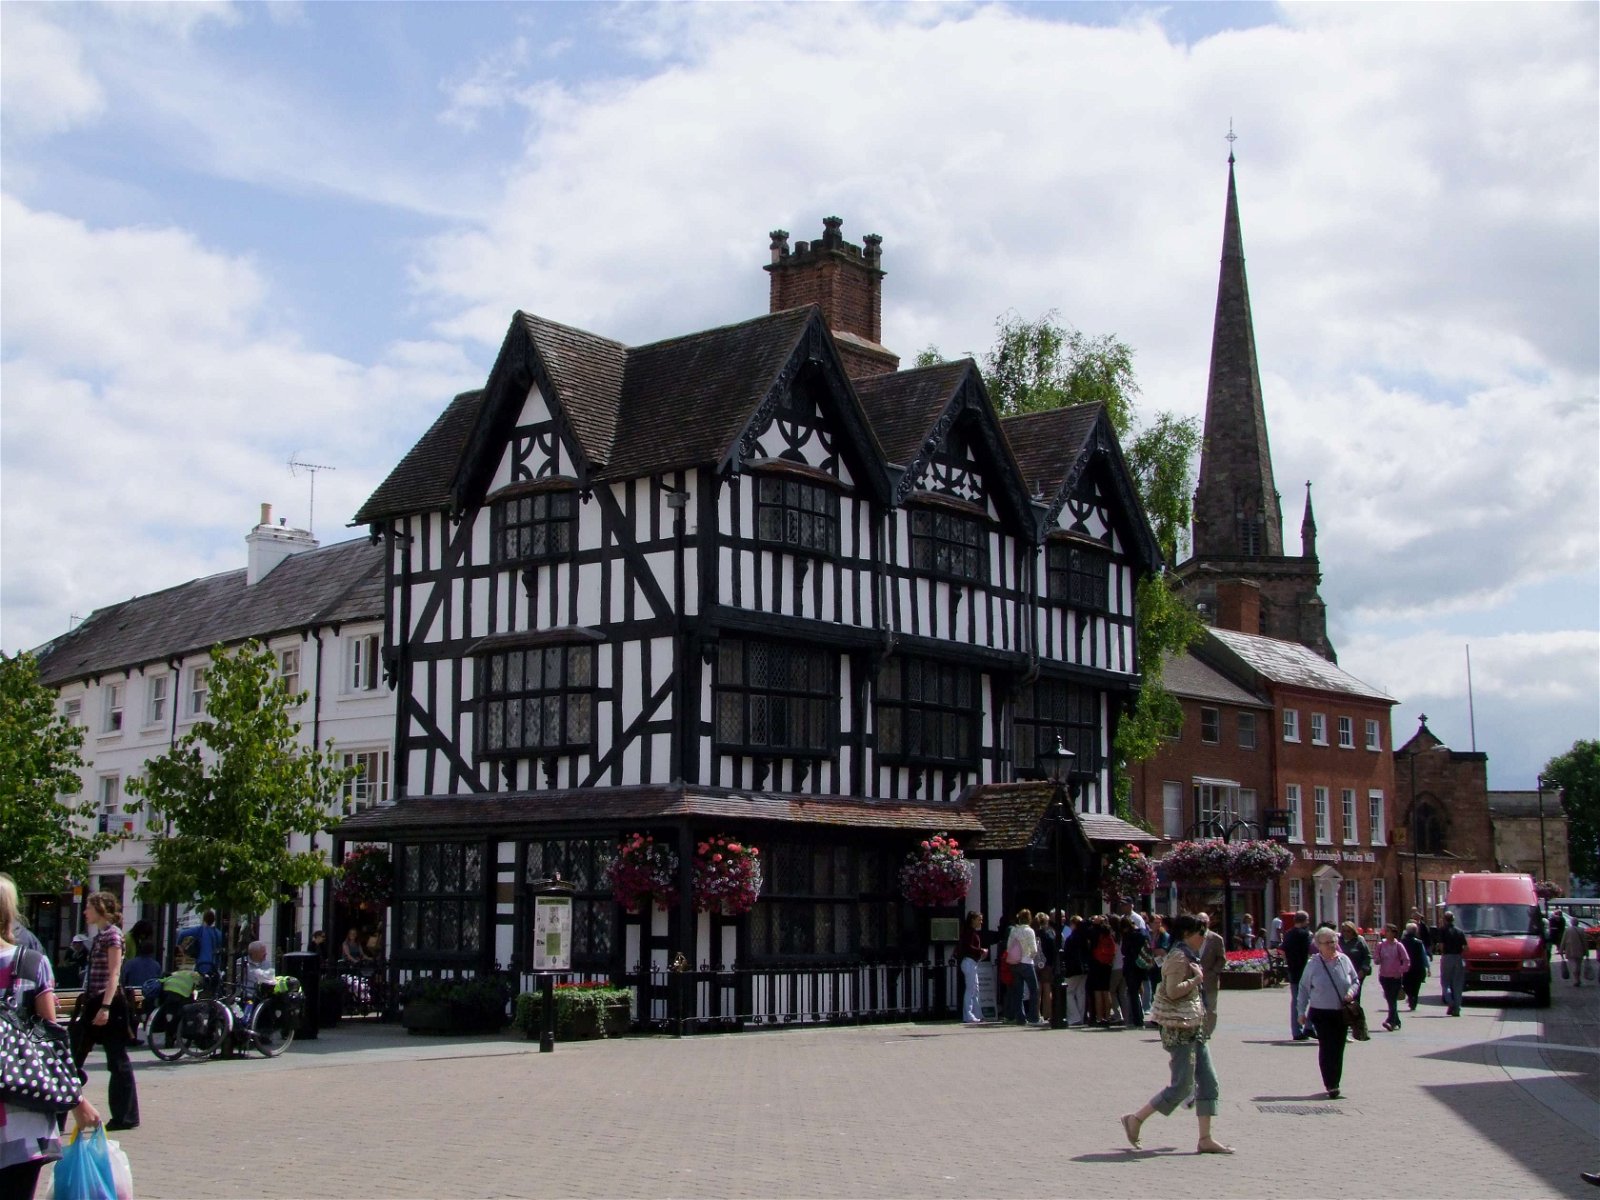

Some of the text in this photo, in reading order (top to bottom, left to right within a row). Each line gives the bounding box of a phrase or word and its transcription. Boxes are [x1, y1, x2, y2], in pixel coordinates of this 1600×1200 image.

[1302, 849, 1313, 860] The
[1314, 850, 1341, 864] Edinburgh
[1342, 851, 1363, 862] Woollen
